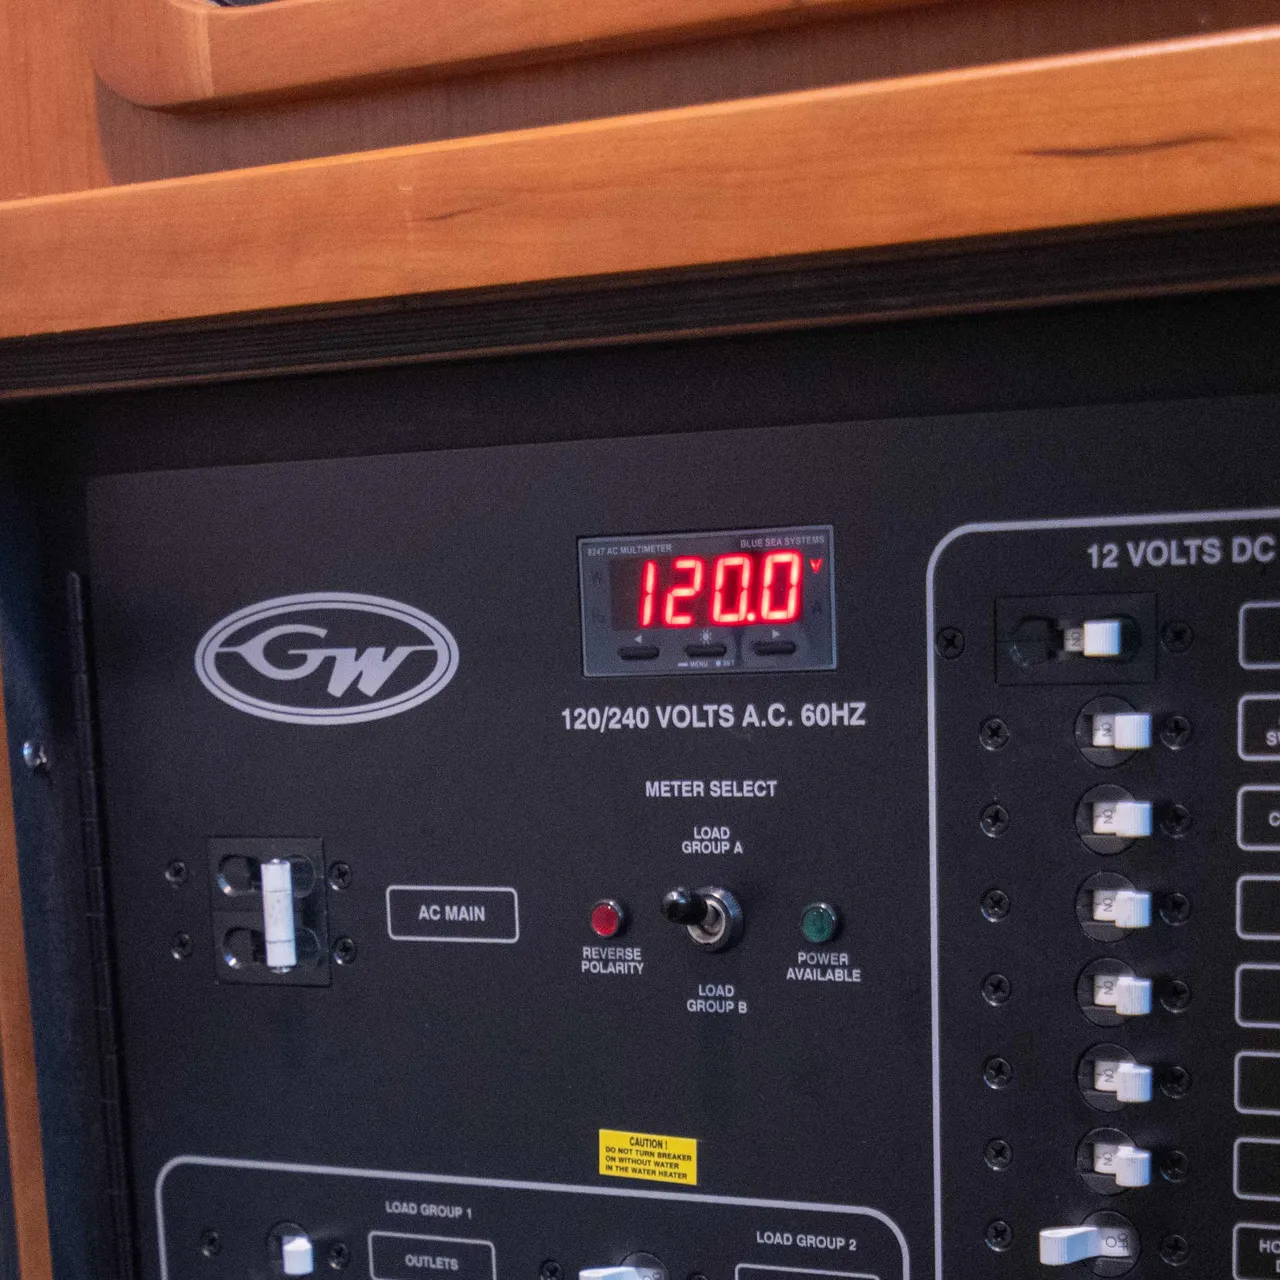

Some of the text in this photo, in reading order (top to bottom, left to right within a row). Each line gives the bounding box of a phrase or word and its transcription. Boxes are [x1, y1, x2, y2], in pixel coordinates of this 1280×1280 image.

[740, 535, 825, 548] BLUE SEA SYSTEMS
[607, 544, 672, 555] AC MULTIMETER
[1087, 534, 1276, 569] 12 VOLTS DC
[638, 550, 804, 628] 120.0
[562, 702, 866, 732] 120/240 VOLTS A.C. 60HZ
[646, 780, 777, 797] METER SELECT
[693, 827, 730, 840] LOAD
[682, 841, 743, 854] GROUP A
[418, 904, 485, 921] AC MAIN
[582, 947, 641, 960] REVERSE
[798, 952, 848, 966] POWER
[581, 961, 644, 974] POLARITY
[786, 968, 861, 982] AVAILABLE
[698, 984, 734, 997] LOAD
[687, 999, 748, 1013] GROUP B
[630, 1137, 663, 1149] CAUTION
[635, 1150, 655, 1158] TURN
[657, 1152, 692, 1161] BREAKER
[618, 1157, 651, 1167] WITHOUT
[654, 1161, 679, 1169] WATER
[385, 1201, 472, 1219] LOAD GROUP 1
[756, 1231, 857, 1250] LOAD GROUP 2
[405, 1254, 458, 1271] OUTLETS
